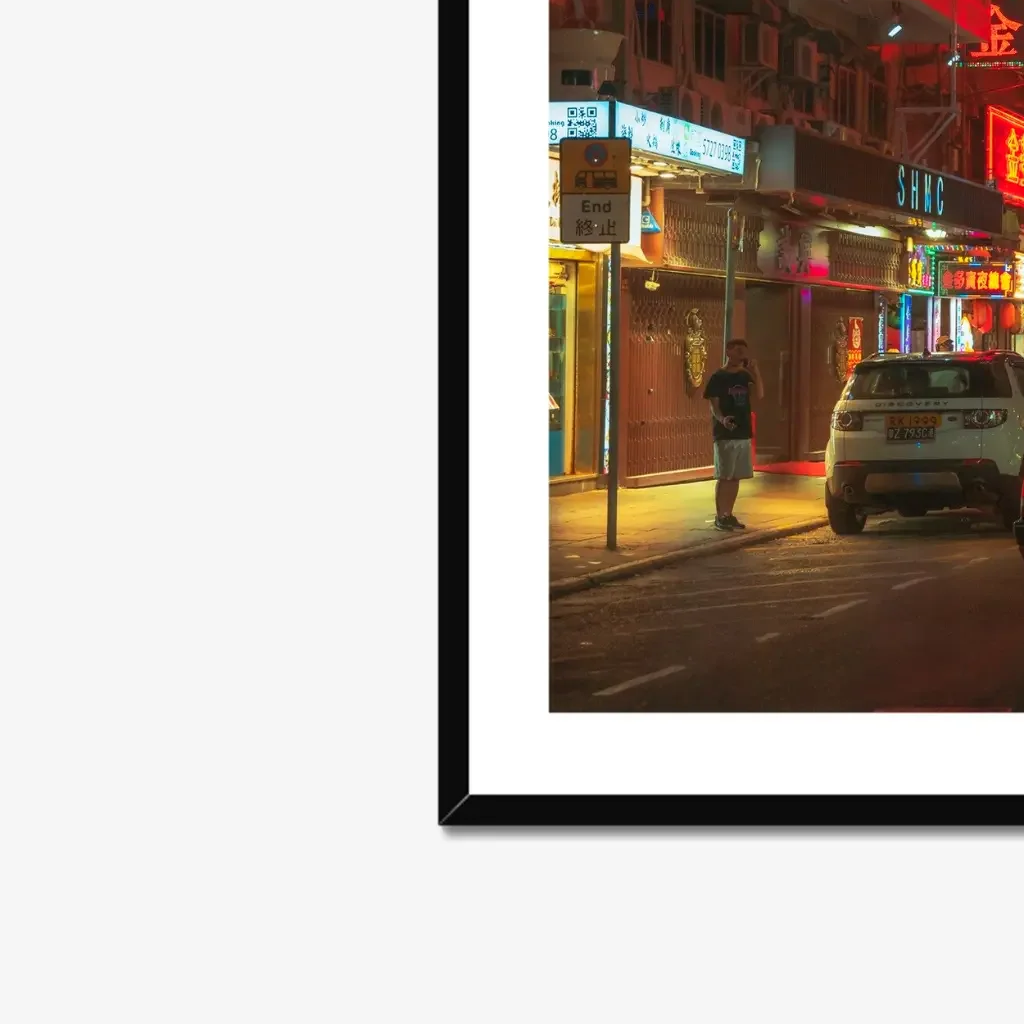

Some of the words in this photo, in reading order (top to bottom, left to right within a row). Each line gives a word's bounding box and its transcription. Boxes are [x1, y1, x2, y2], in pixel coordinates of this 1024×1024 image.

[897, 164, 945, 216] SHMC
[581, 200, 612, 213] End
[575, 218, 618, 237] 終止
[875, 400, 949, 408] DISCOVERY
